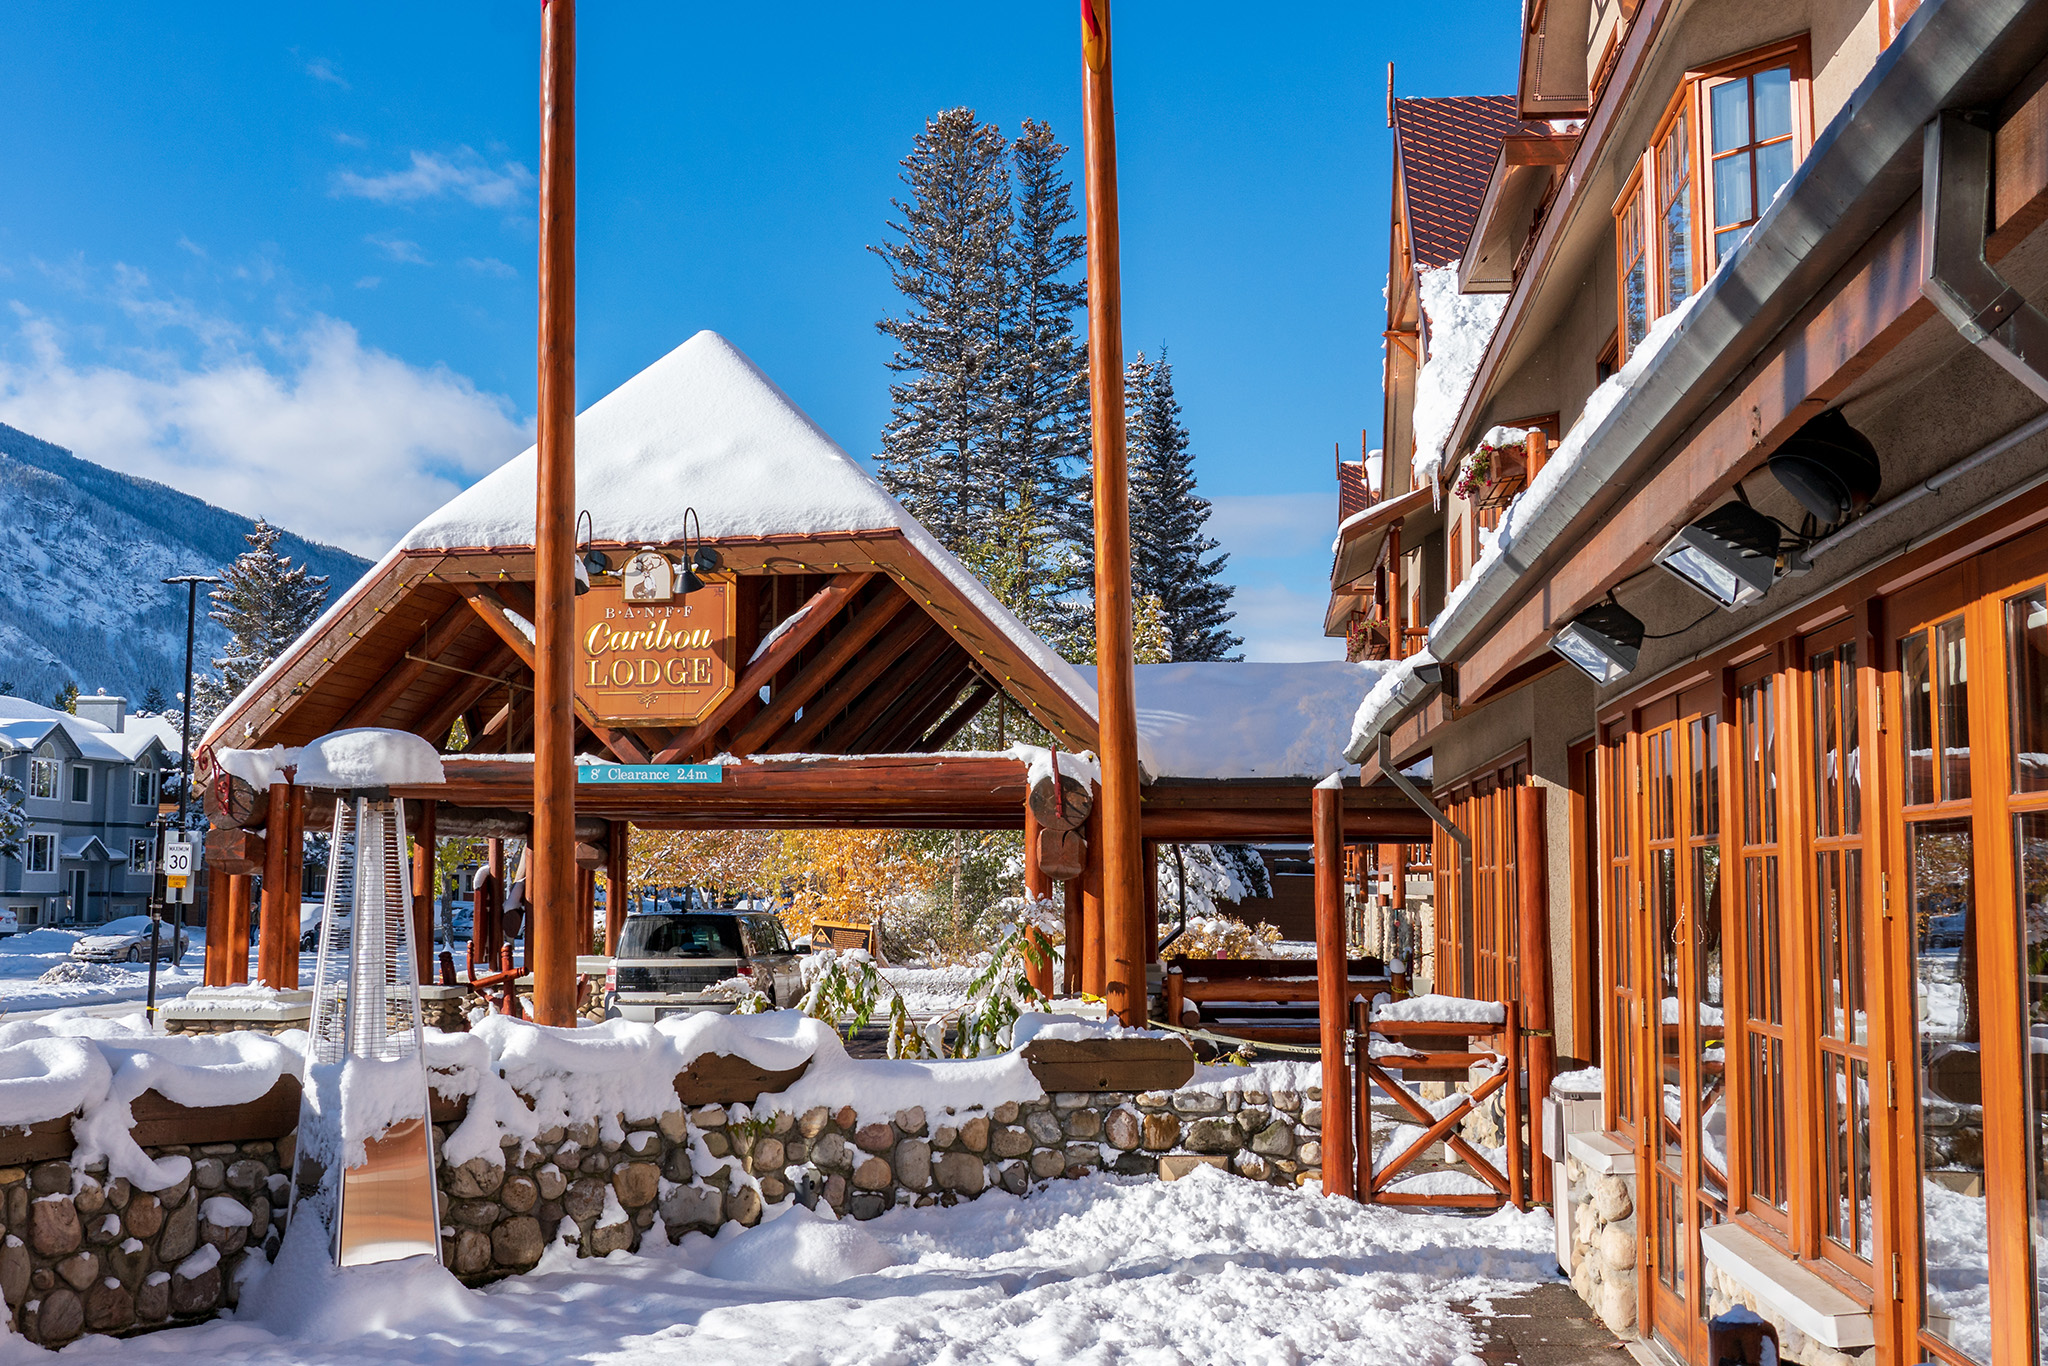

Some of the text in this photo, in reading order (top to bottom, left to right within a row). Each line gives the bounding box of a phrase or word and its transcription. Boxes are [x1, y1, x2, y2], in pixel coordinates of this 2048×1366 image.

[583, 619, 713, 656] Caribou
[585, 657, 712, 687] LODGE
[608, 768, 670, 780] Clearance
[677, 768, 708, 780] 2.4m
[169, 855, 188, 870] 30
